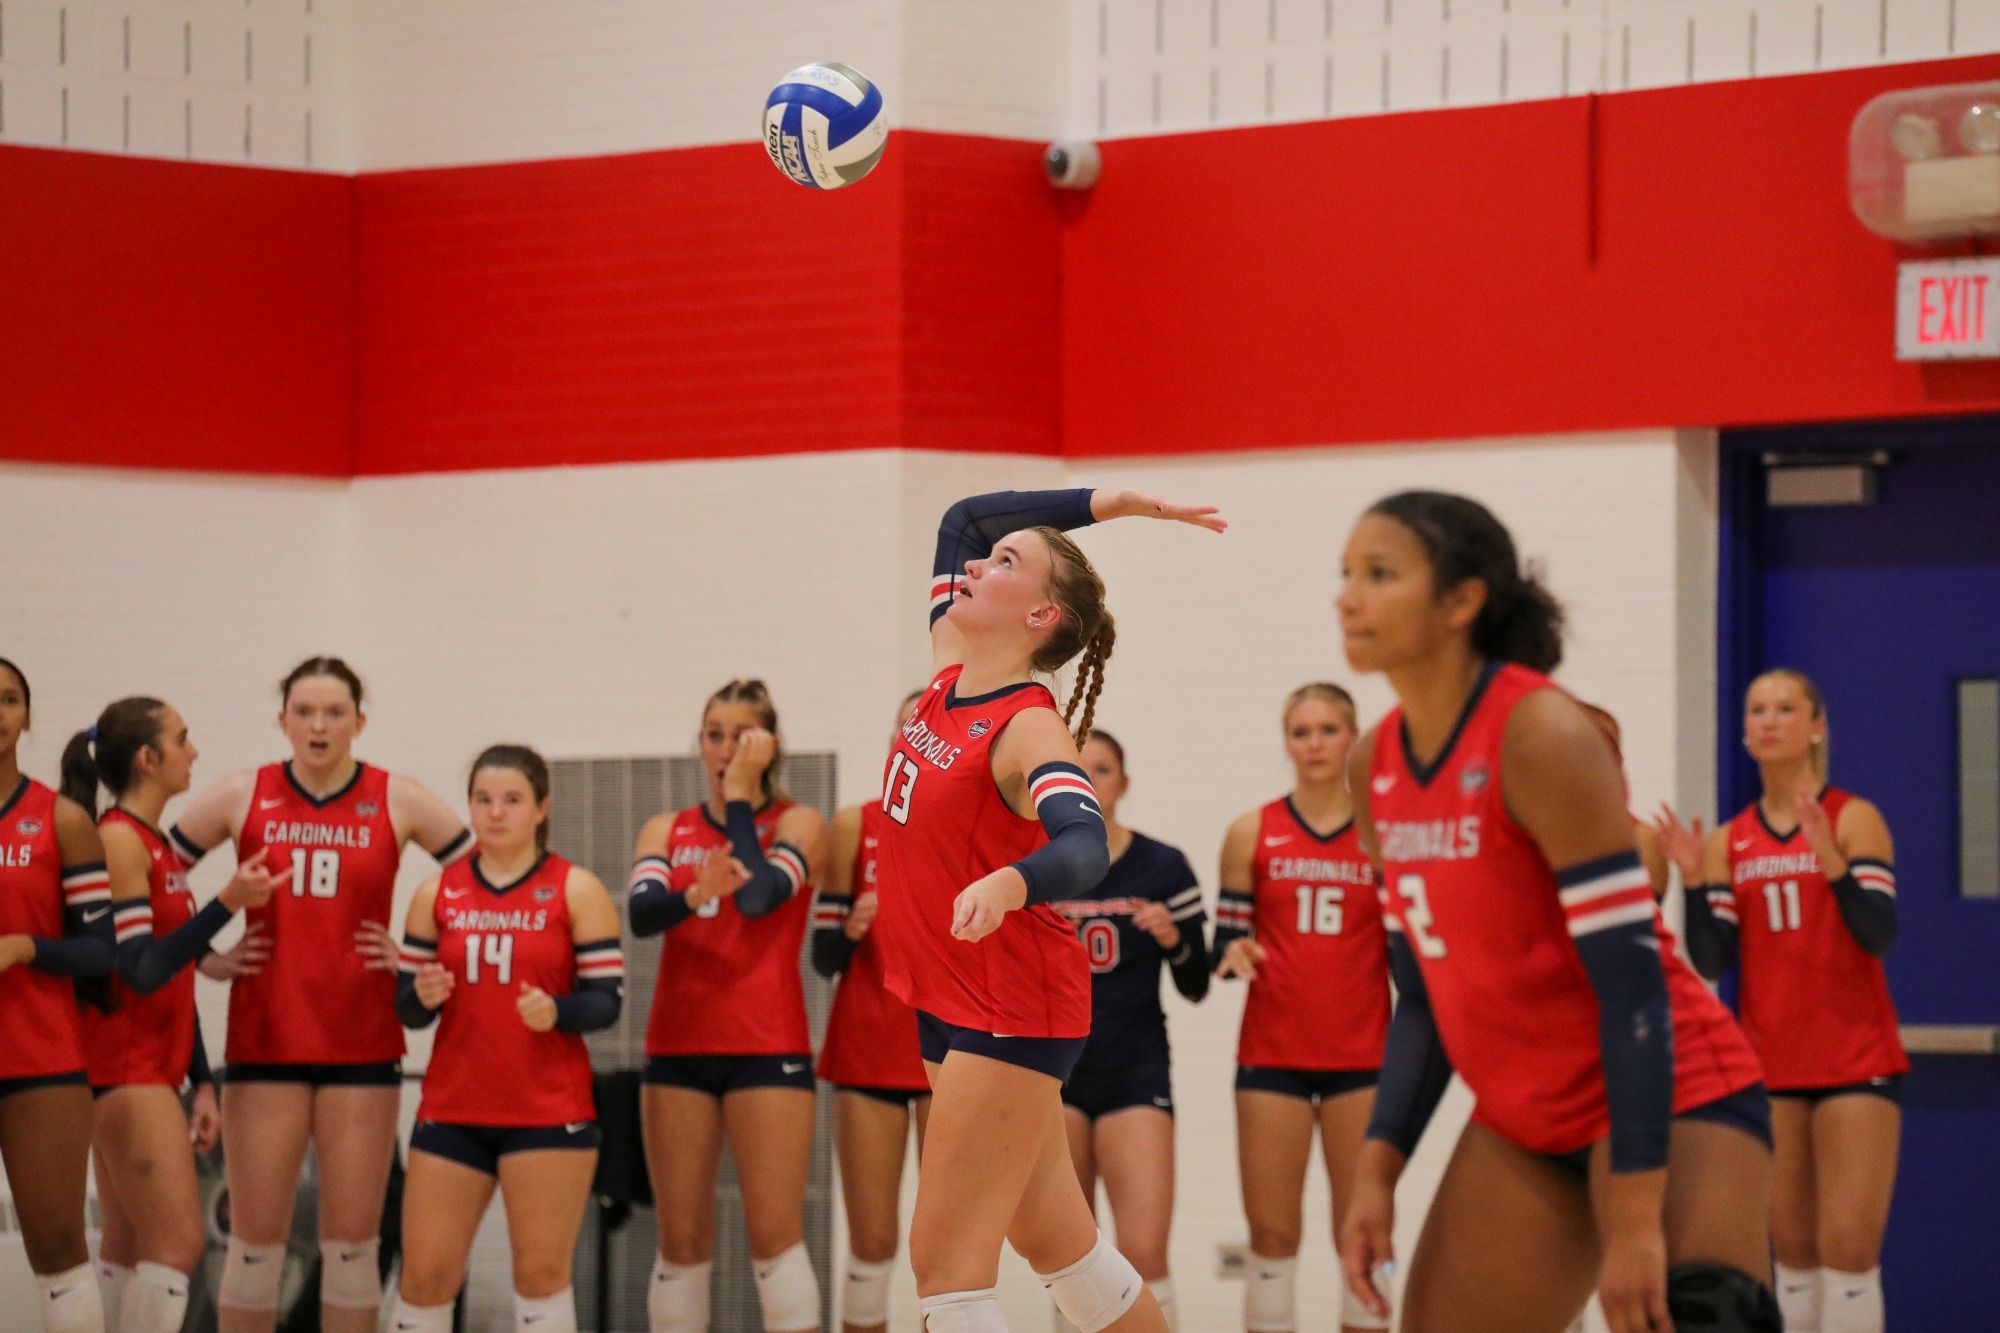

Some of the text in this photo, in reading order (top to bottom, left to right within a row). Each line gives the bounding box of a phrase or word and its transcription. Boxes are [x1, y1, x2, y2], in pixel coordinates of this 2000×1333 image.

[1918, 275, 1990, 343] EXIT
[883, 750, 919, 826] 13
[263, 820, 371, 849] CARDINALS
[290, 847, 340, 899] 18
[1268, 856, 1374, 886] CARDINALS
[1734, 851, 1822, 885] CARDINAL
[445, 907, 548, 931] CARDINALS
[1295, 884, 1345, 936] 16
[1397, 873, 1447, 960] 2
[1762, 879, 1801, 932] 11
[465, 933, 514, 985] 14
